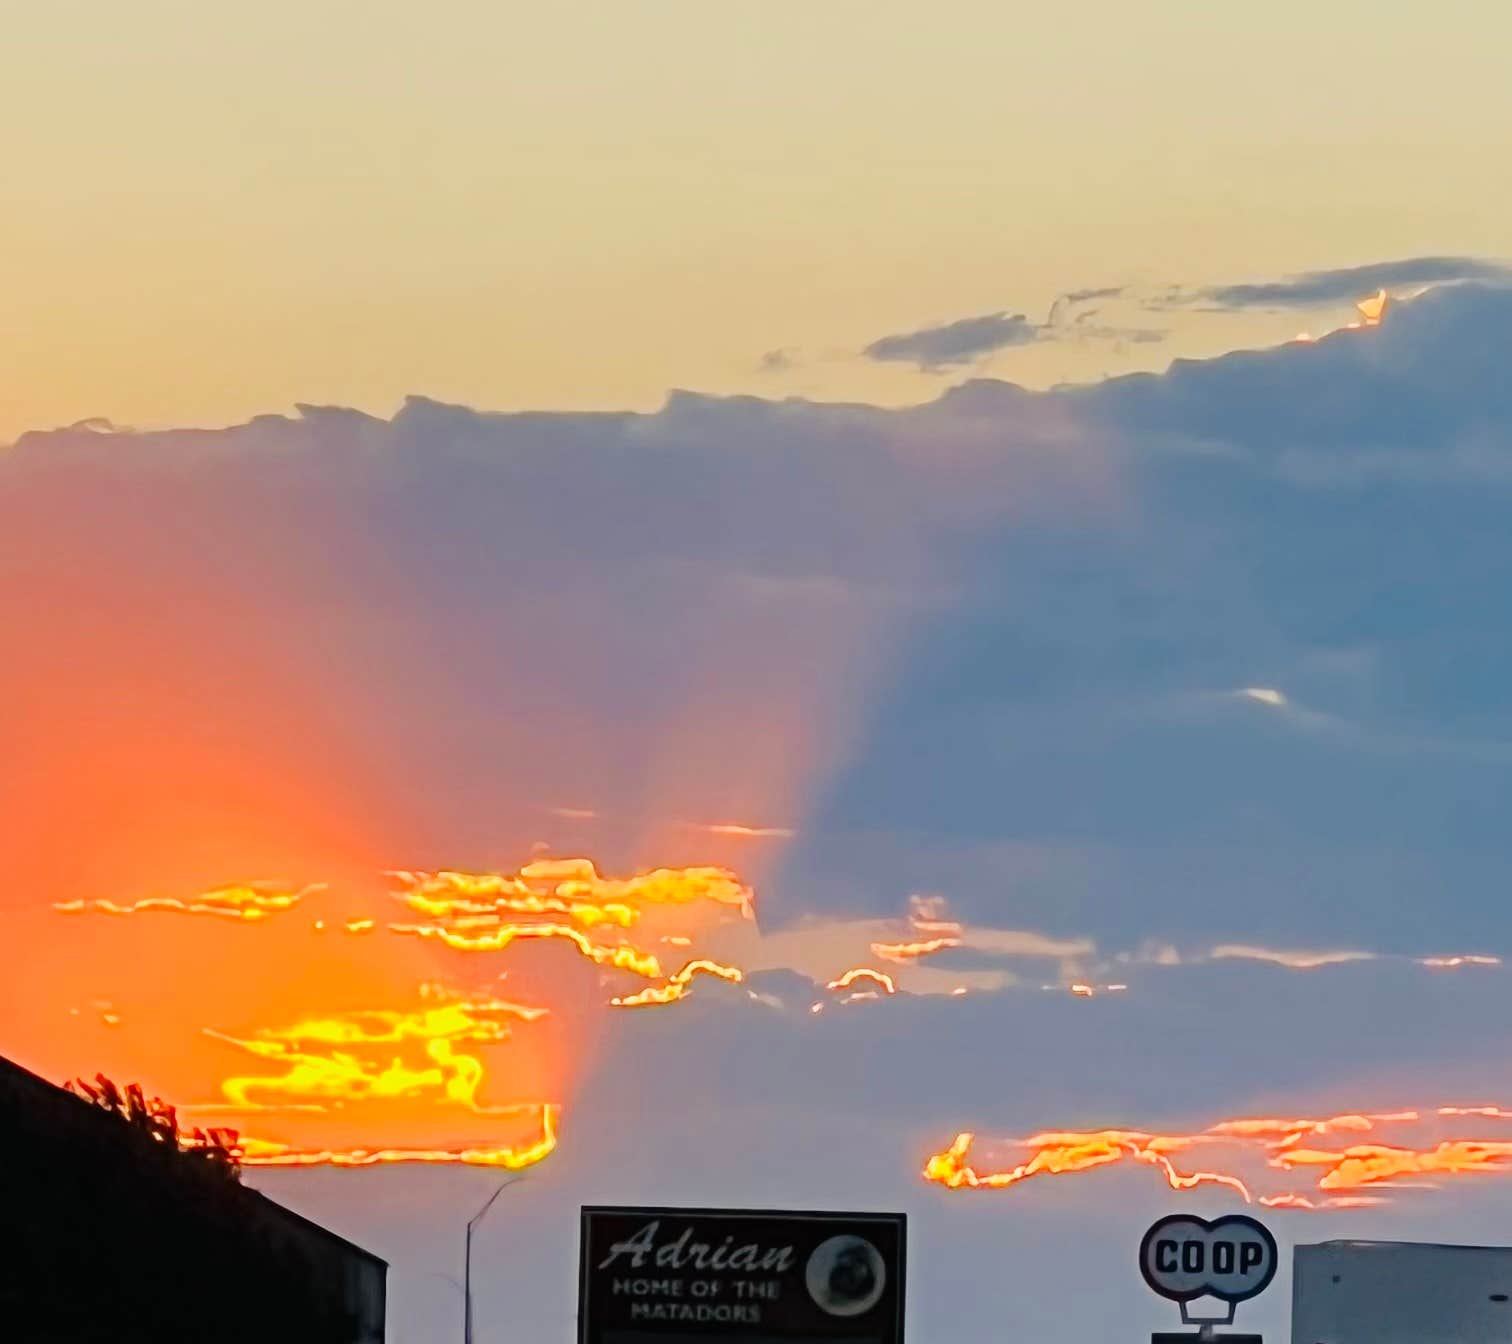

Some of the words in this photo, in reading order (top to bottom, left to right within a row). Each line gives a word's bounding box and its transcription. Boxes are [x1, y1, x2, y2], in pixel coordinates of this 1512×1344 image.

[599, 1220, 797, 1272] Adrian
[1155, 1239, 1263, 1275] COOP
[612, 1277, 685, 1297] HOME
[691, 1279, 720, 1298] OF
[729, 1280, 781, 1300] THE
[631, 1302, 761, 1323] MATADORS
